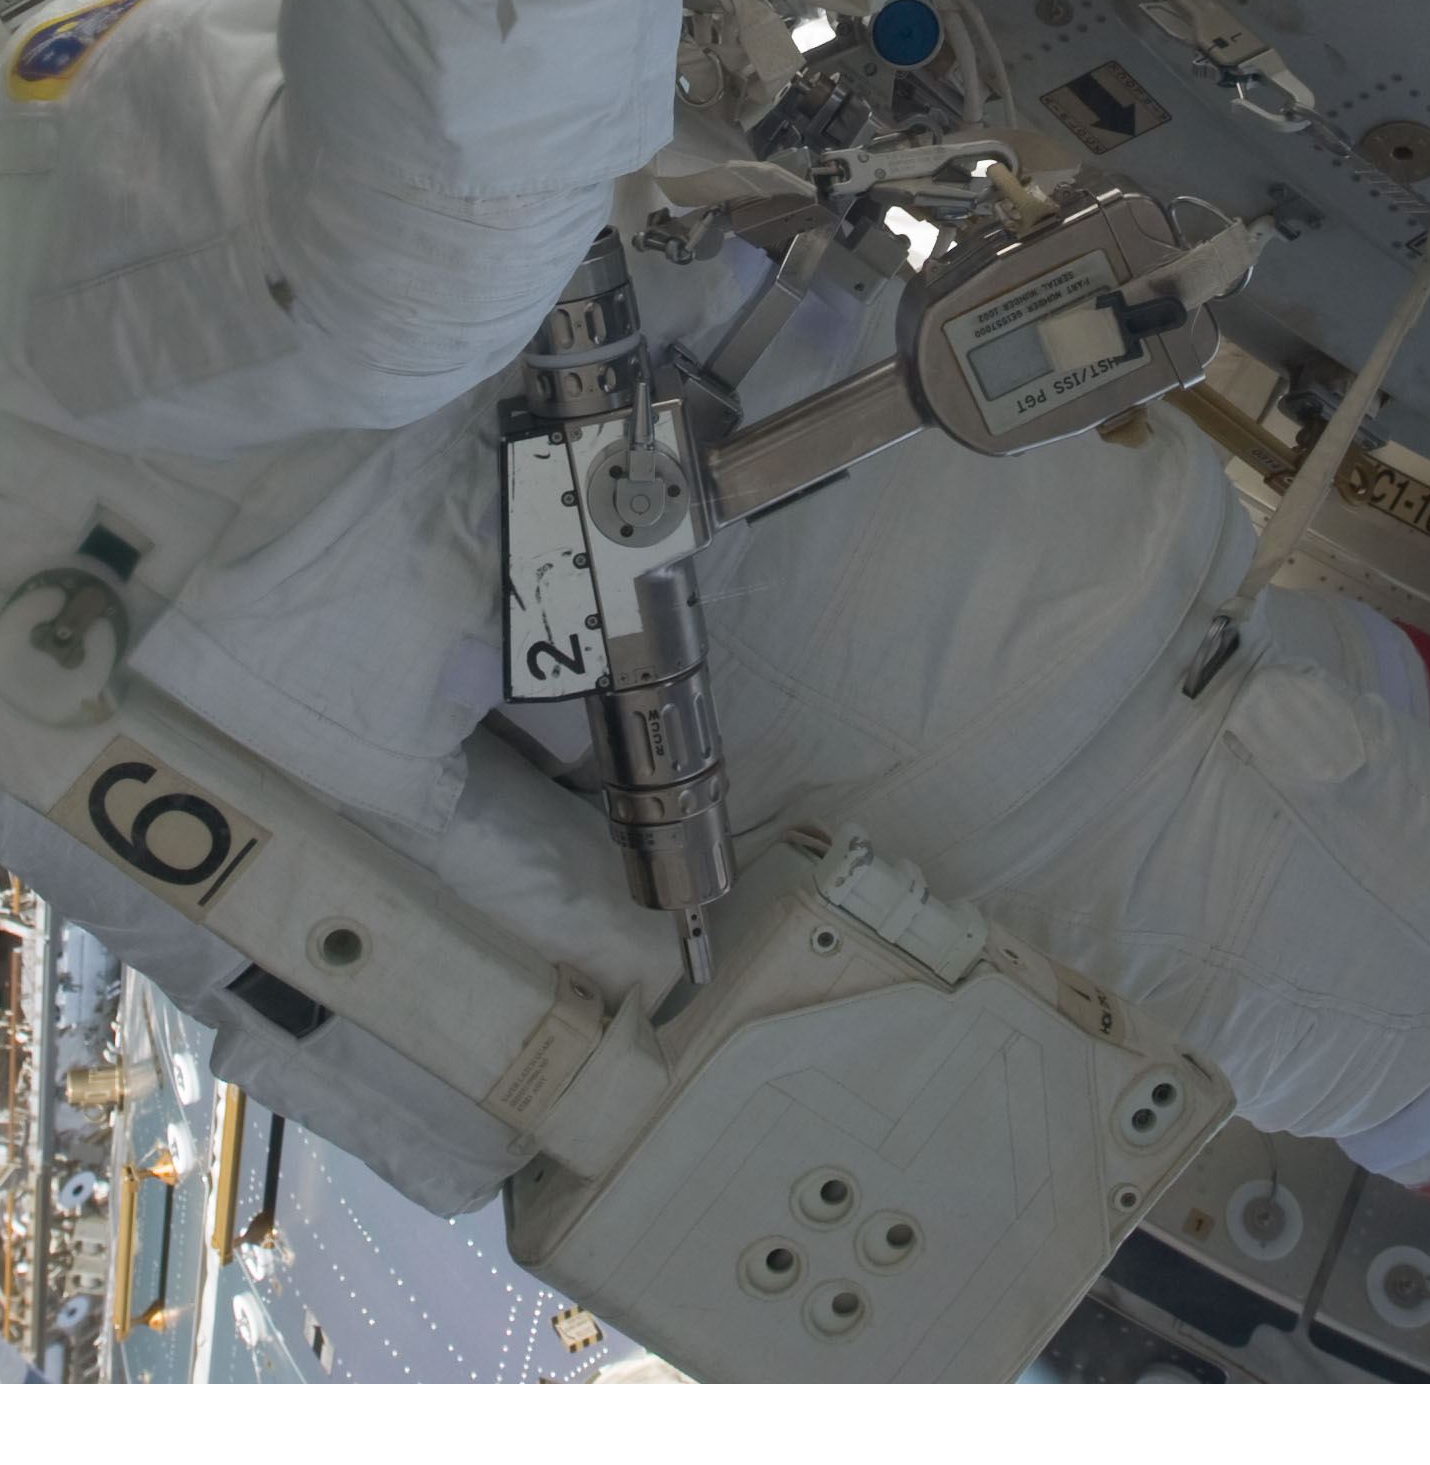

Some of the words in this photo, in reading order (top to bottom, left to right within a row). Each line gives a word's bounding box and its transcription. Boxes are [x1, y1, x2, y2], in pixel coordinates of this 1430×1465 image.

[1002, 289, 1037, 310] NUMBER
[1026, 293, 1062, 313] NUMBER
[1053, 356, 1119, 395] HST/ISS
[1016, 388, 1047, 414] PGT
[527, 632, 586, 682] 2
